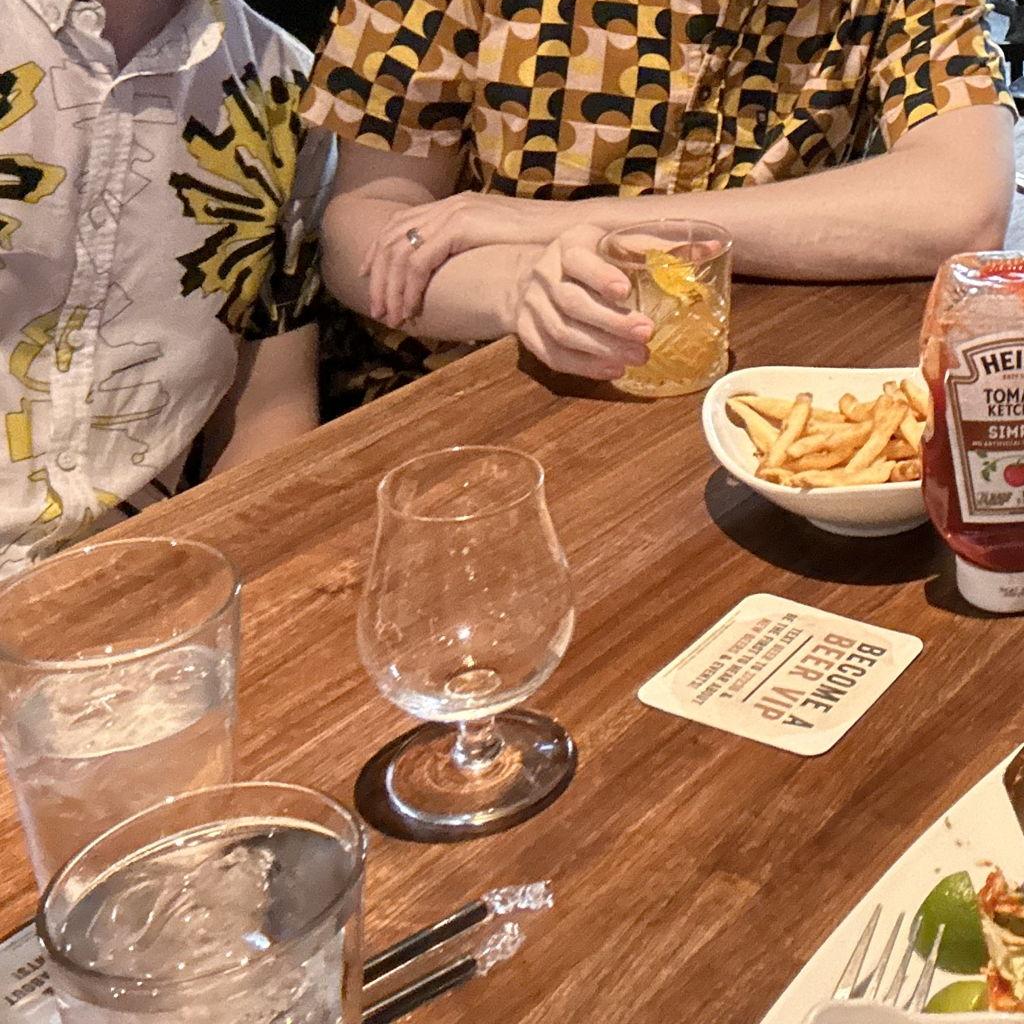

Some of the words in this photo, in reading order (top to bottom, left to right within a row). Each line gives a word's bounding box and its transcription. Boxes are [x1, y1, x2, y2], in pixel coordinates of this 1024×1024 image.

[766, 621, 788, 636] THE
[781, 612, 799, 623] BE
[745, 634, 775, 656] FIRST
[788, 632, 857, 682] BEER
[799, 642, 887, 714] BECOME
[752, 685, 806, 722] VIP
[781, 714, 815, 730] A
